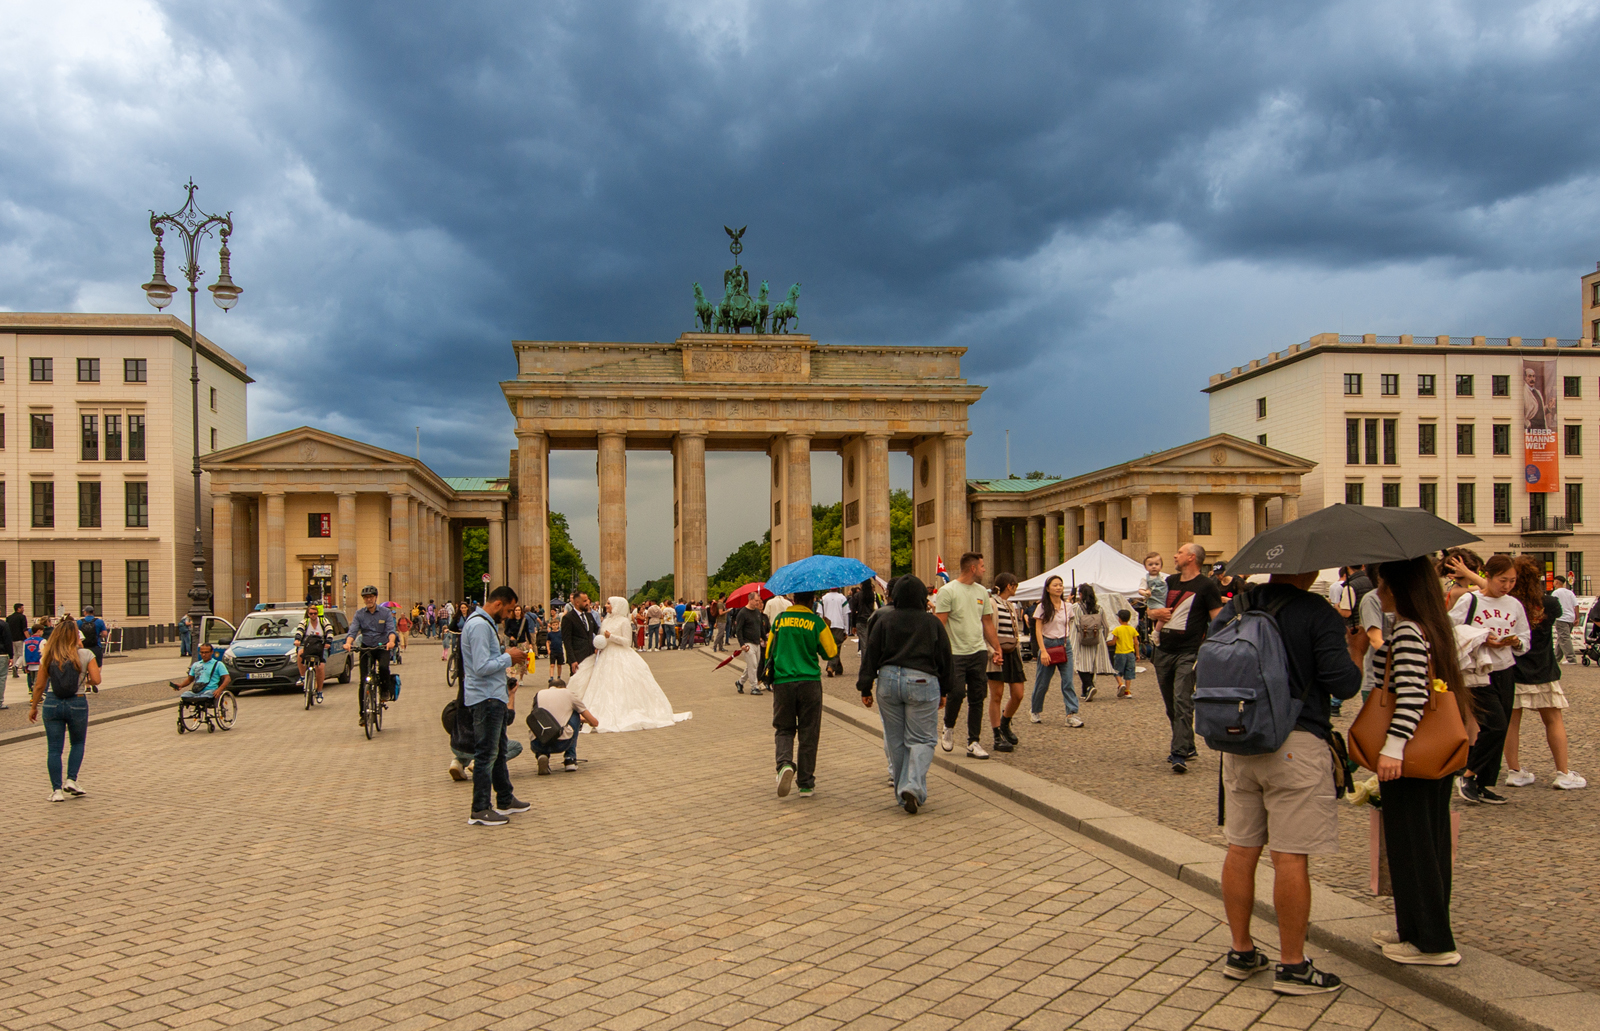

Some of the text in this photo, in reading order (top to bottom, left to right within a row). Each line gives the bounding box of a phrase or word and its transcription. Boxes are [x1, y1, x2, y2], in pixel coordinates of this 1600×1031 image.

[1525, 428, 1556, 436] LIEBER-
[1525, 435, 1556, 443] MANNS
[1525, 442, 1547, 450] WELT
[1473, 609, 1517, 628] PARIS
[775, 616, 816, 632] CAMEROON
